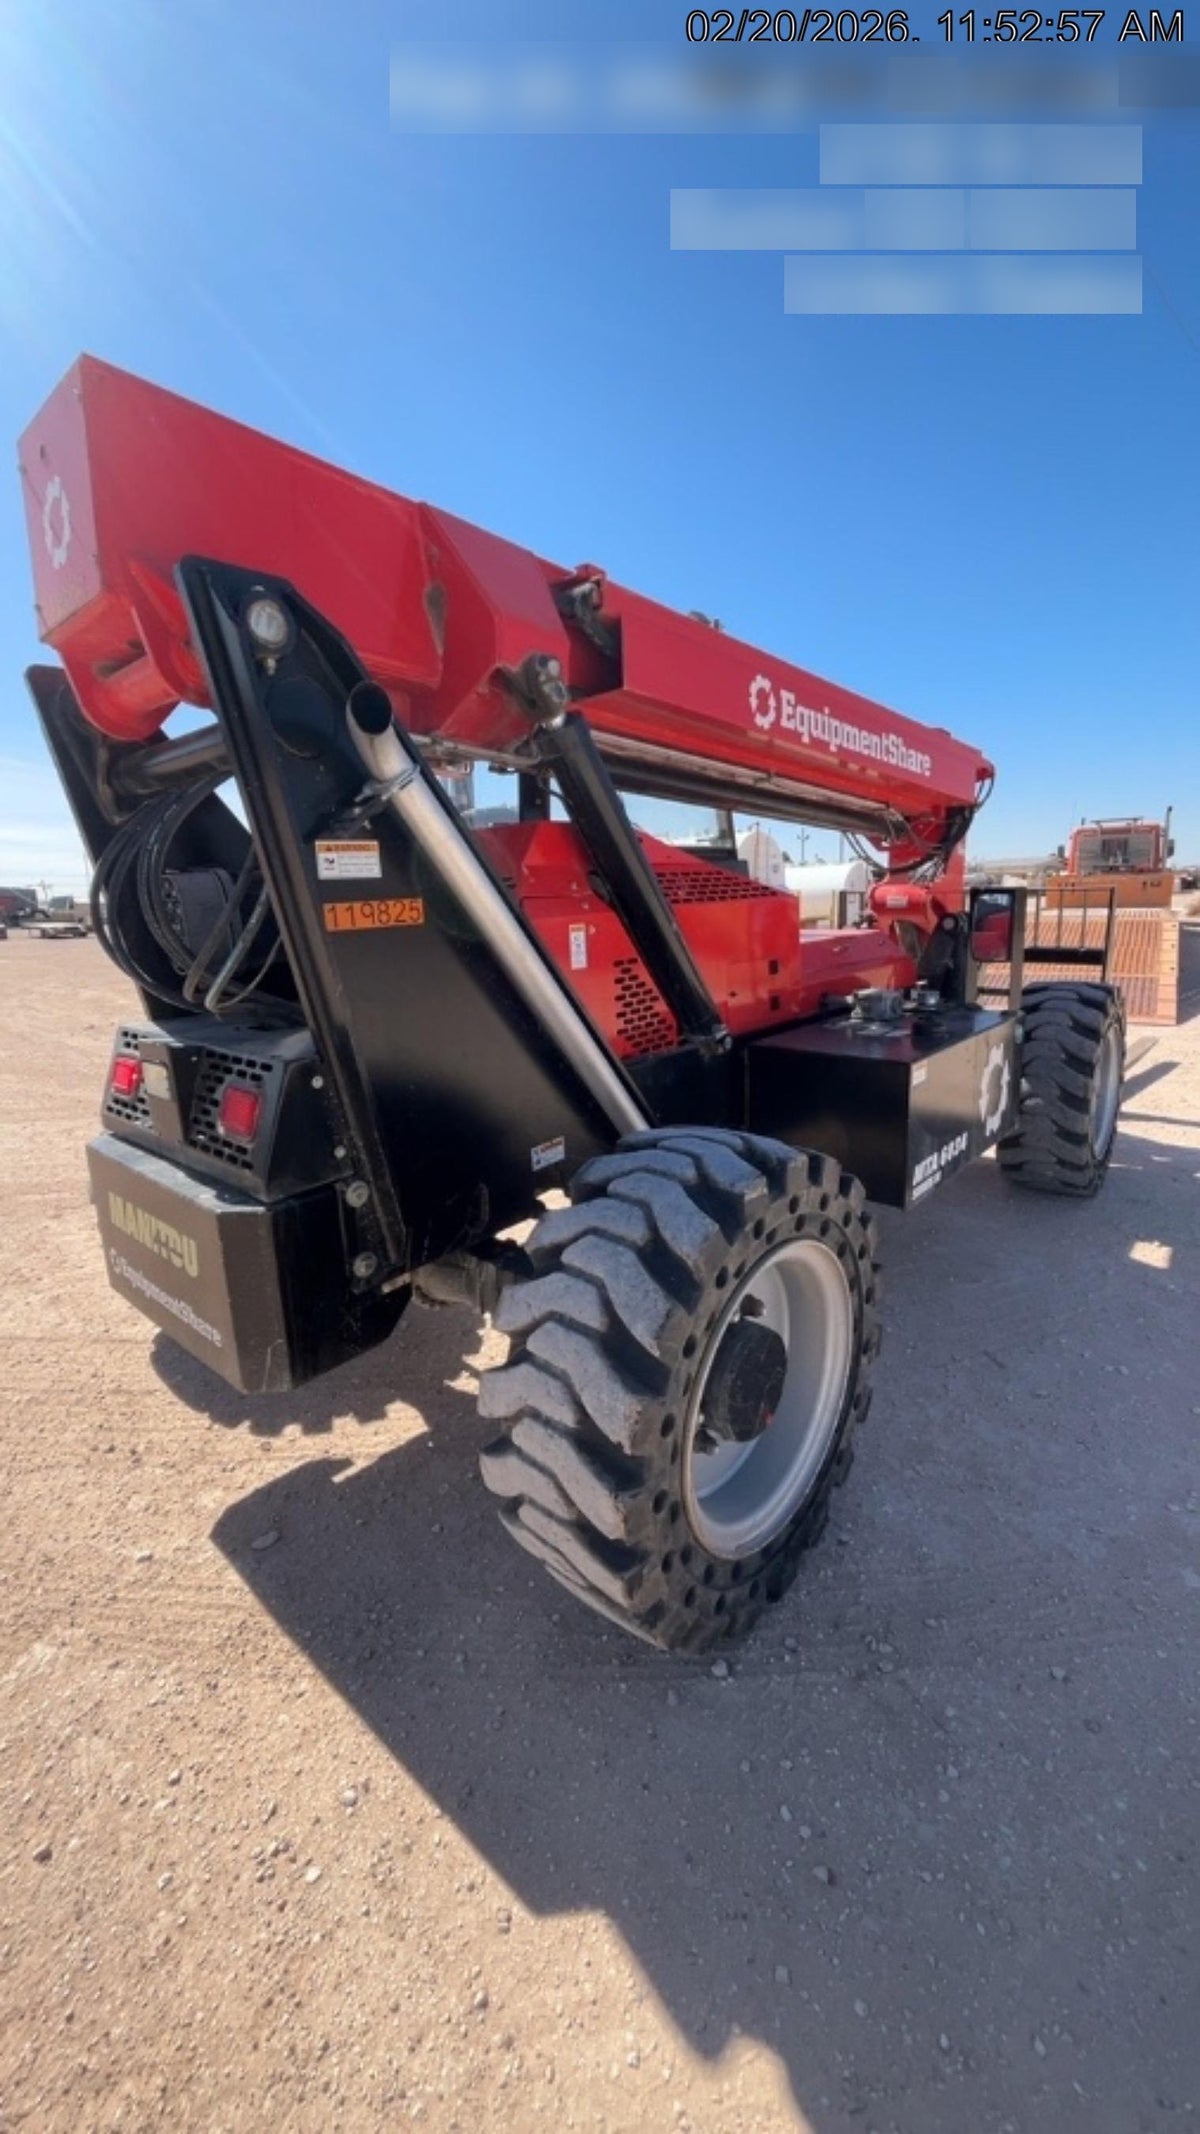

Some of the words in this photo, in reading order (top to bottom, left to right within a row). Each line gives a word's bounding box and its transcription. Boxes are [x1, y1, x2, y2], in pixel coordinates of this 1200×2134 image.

[779, 688, 932, 776] EquipmentShare
[326, 900, 421, 928] 119825
[108, 1190, 199, 1278] MANITOU
